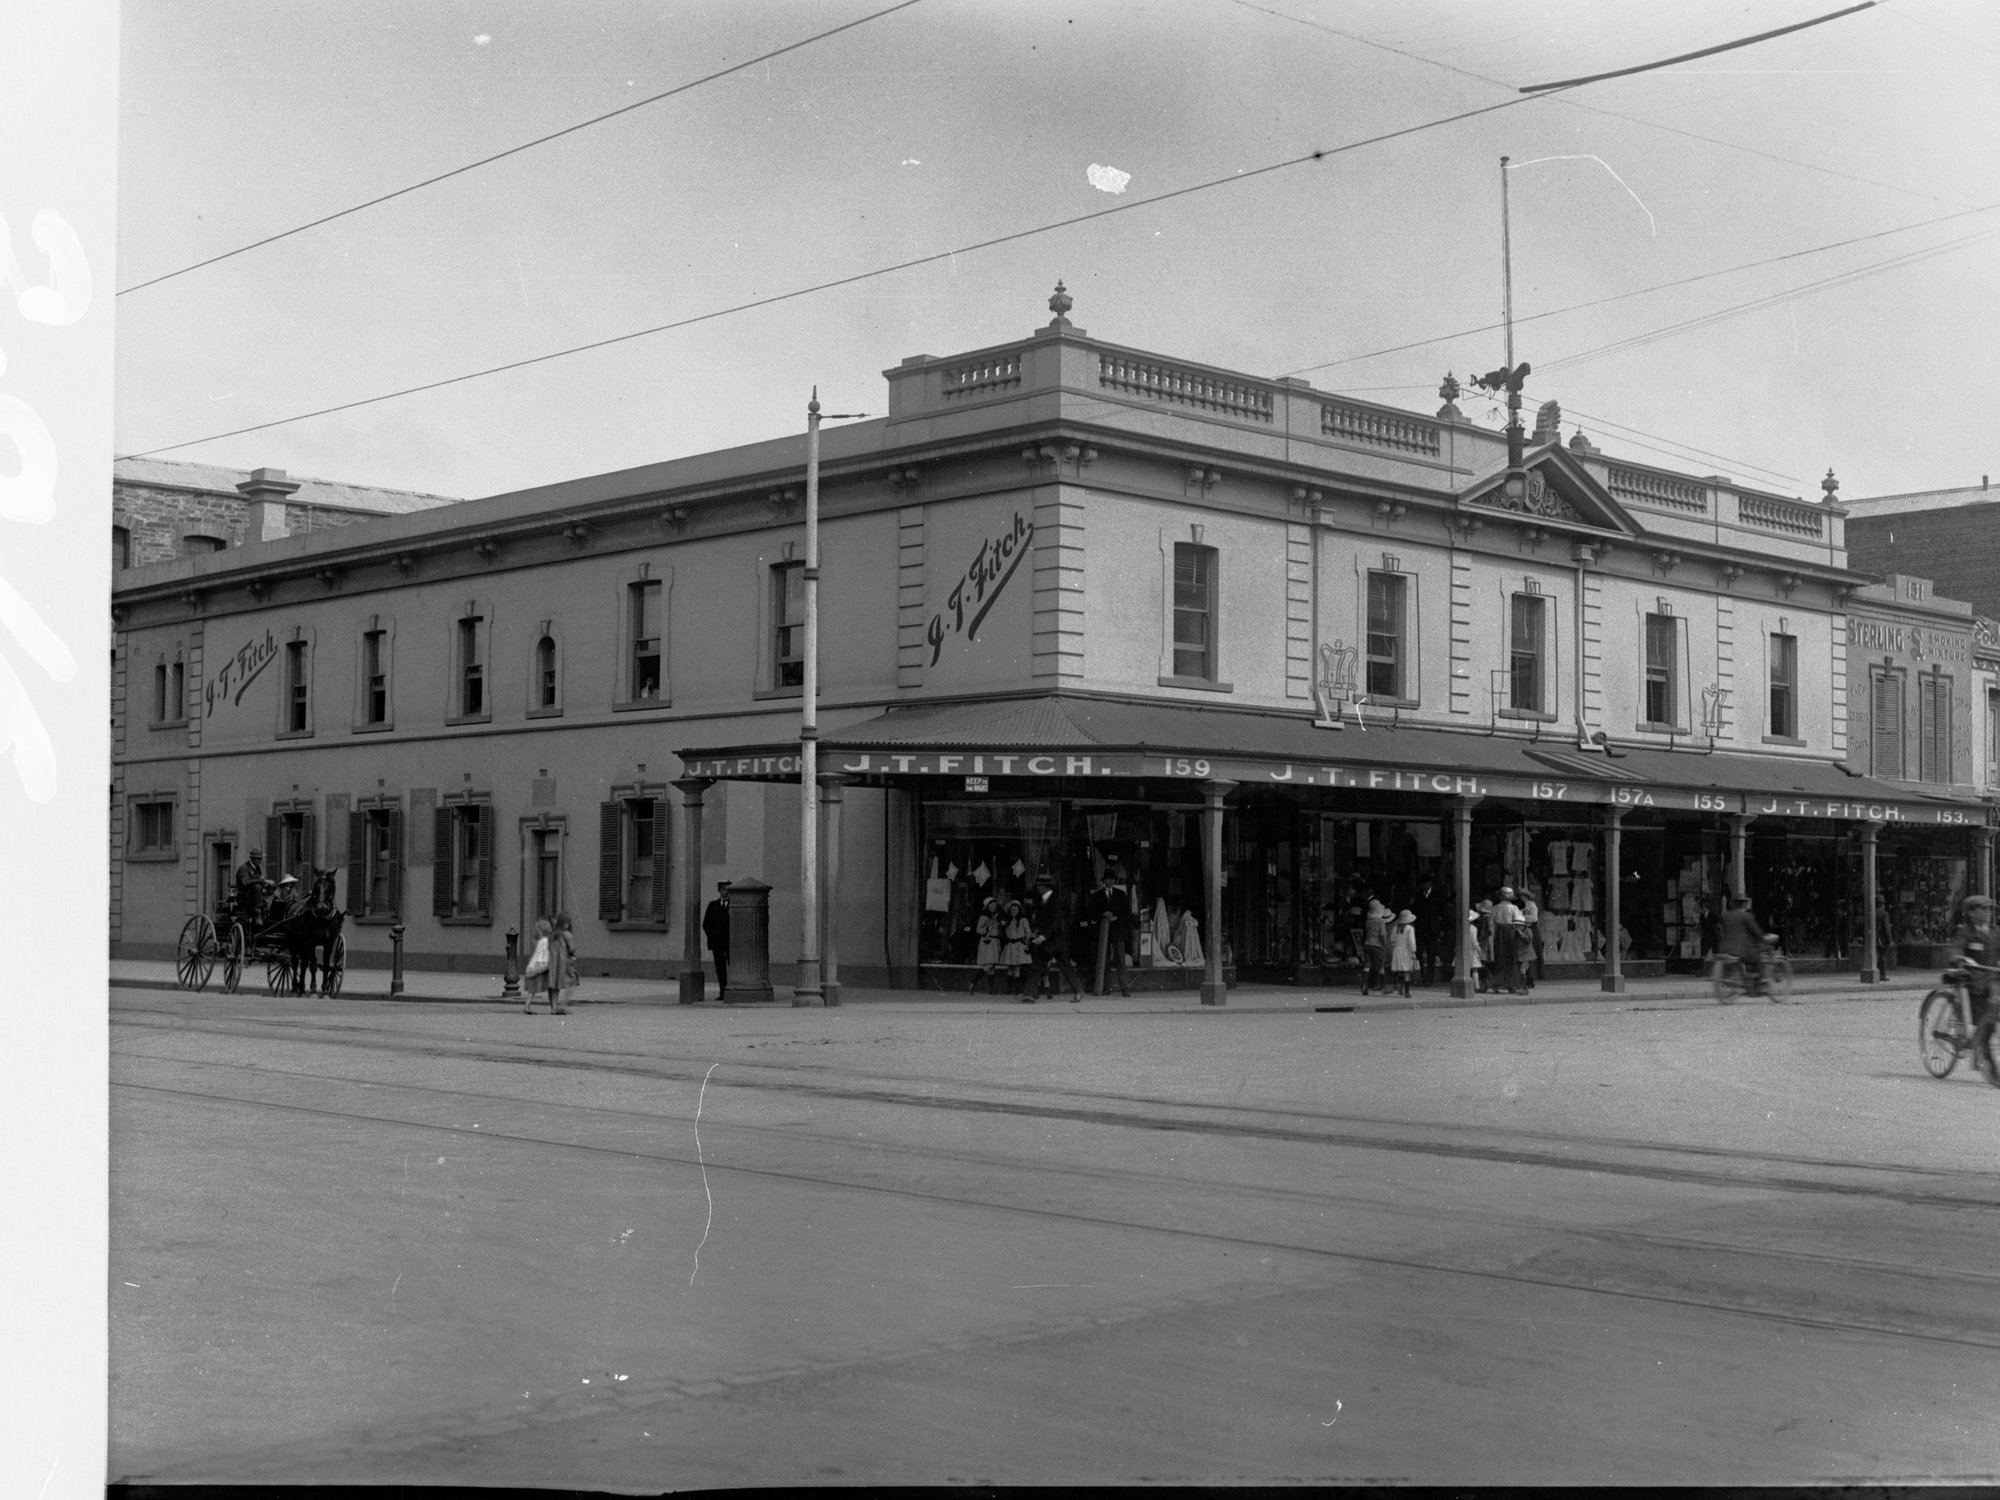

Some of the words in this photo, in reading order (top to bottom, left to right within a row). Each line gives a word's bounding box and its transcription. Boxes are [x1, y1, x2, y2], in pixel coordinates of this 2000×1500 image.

[1848, 618, 1905, 653] STERLING
[1929, 632, 1966, 649] SMOKING
[1929, 646, 1965, 662] MIXTURE
[1165, 757, 1211, 777] 159
[966, 777, 982, 785] KEEP
[1532, 781, 1568, 799] 157
[1611, 786, 1655, 806] 157A
[1694, 794, 1725, 810] 155
